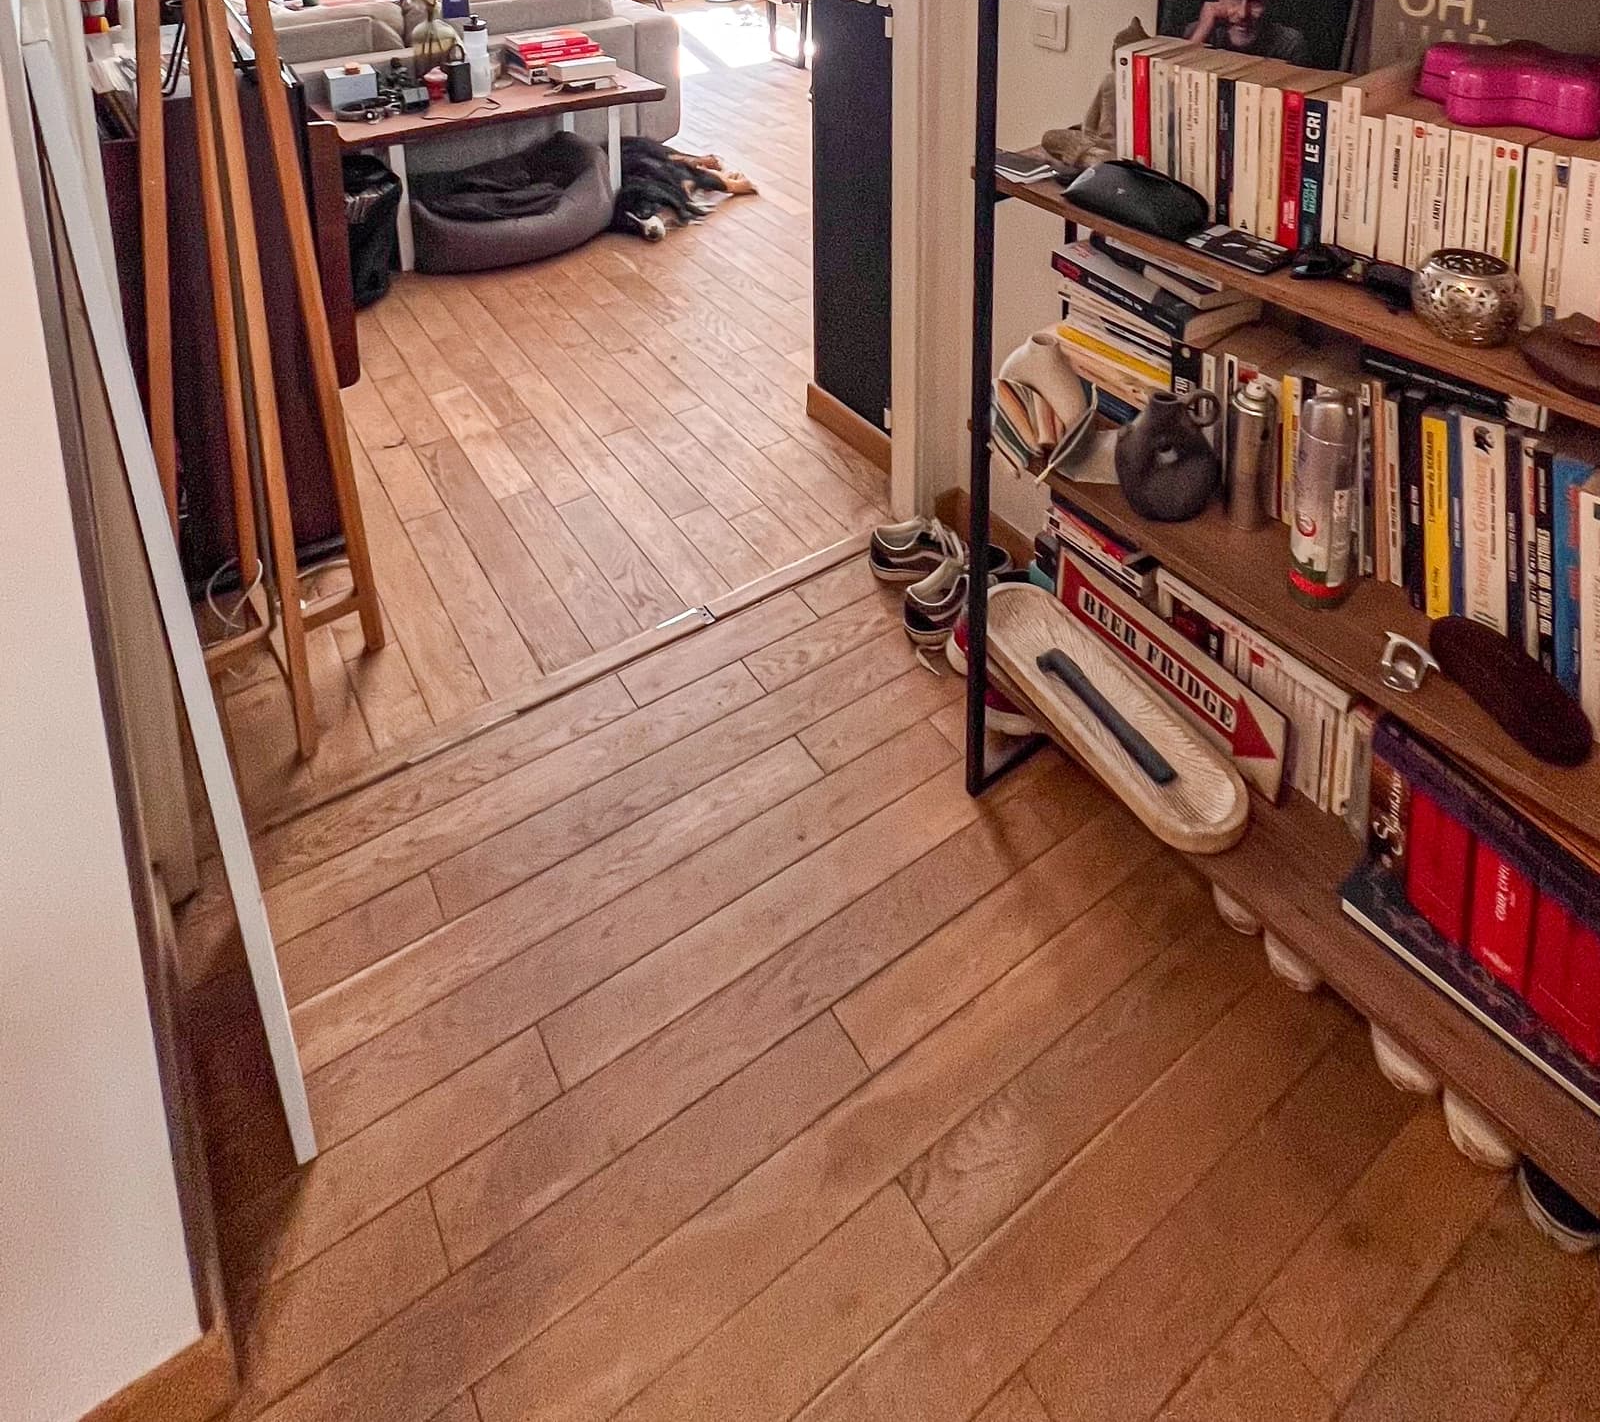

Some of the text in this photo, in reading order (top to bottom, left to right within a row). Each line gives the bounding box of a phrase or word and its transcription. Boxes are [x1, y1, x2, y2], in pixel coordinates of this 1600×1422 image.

[1305, 111, 1322, 162] LE CRI
[1083, 588, 1137, 651] BEER
[1146, 640, 1235, 731] FRIDGE
